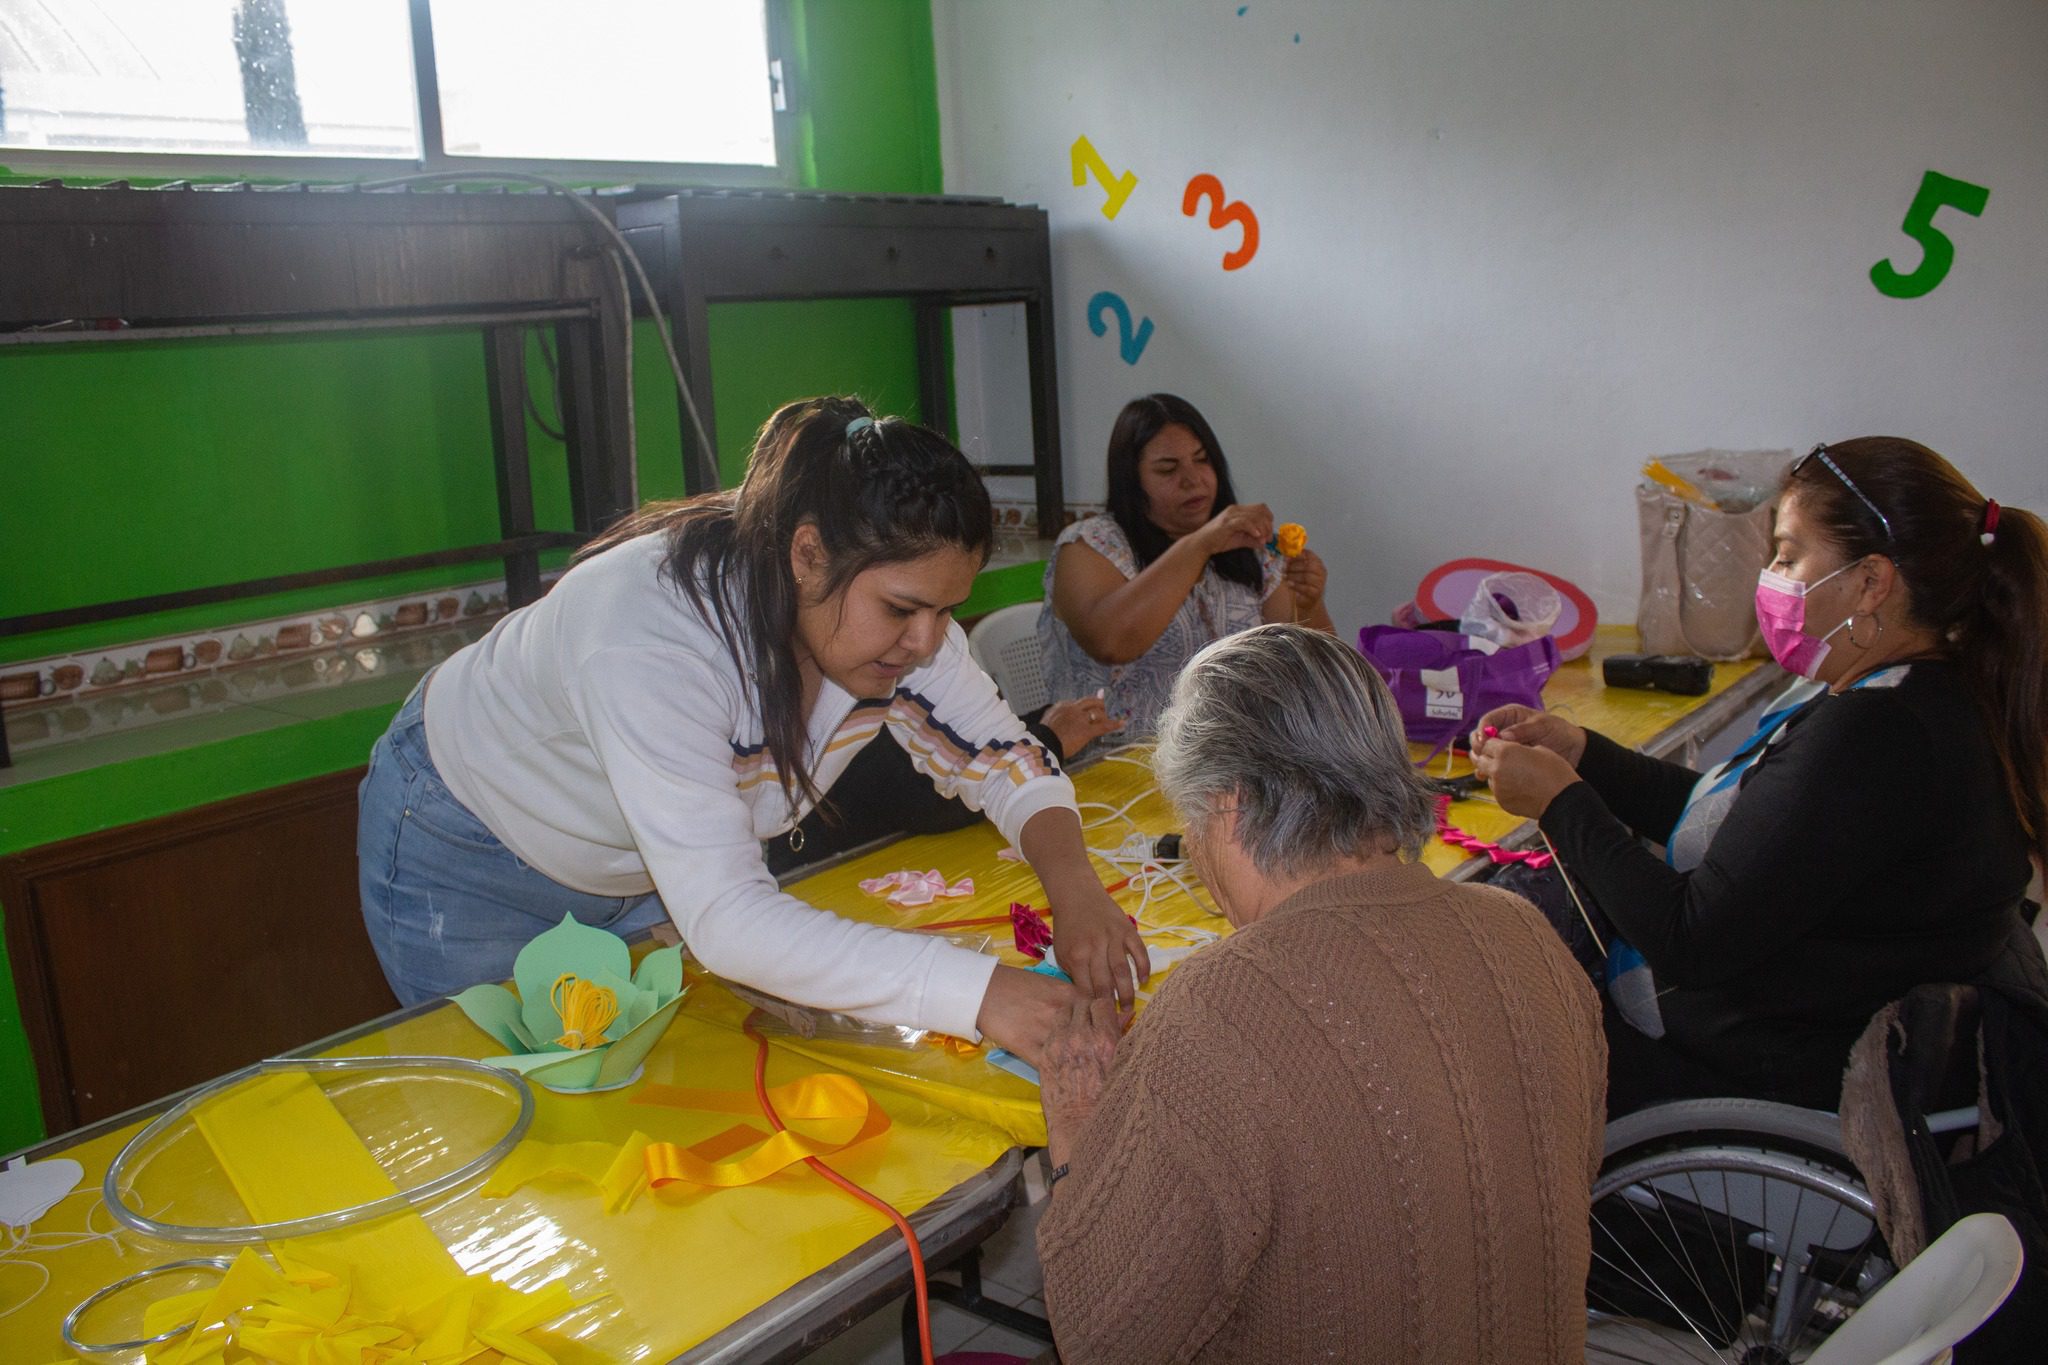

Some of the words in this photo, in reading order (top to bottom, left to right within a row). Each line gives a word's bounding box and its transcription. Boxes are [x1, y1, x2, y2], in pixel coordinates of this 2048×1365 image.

[1070, 135, 1138, 221] 1
[1182, 173, 1260, 272] 3
[1870, 170, 1990, 299] 5
[1087, 291, 1154, 365] 2
